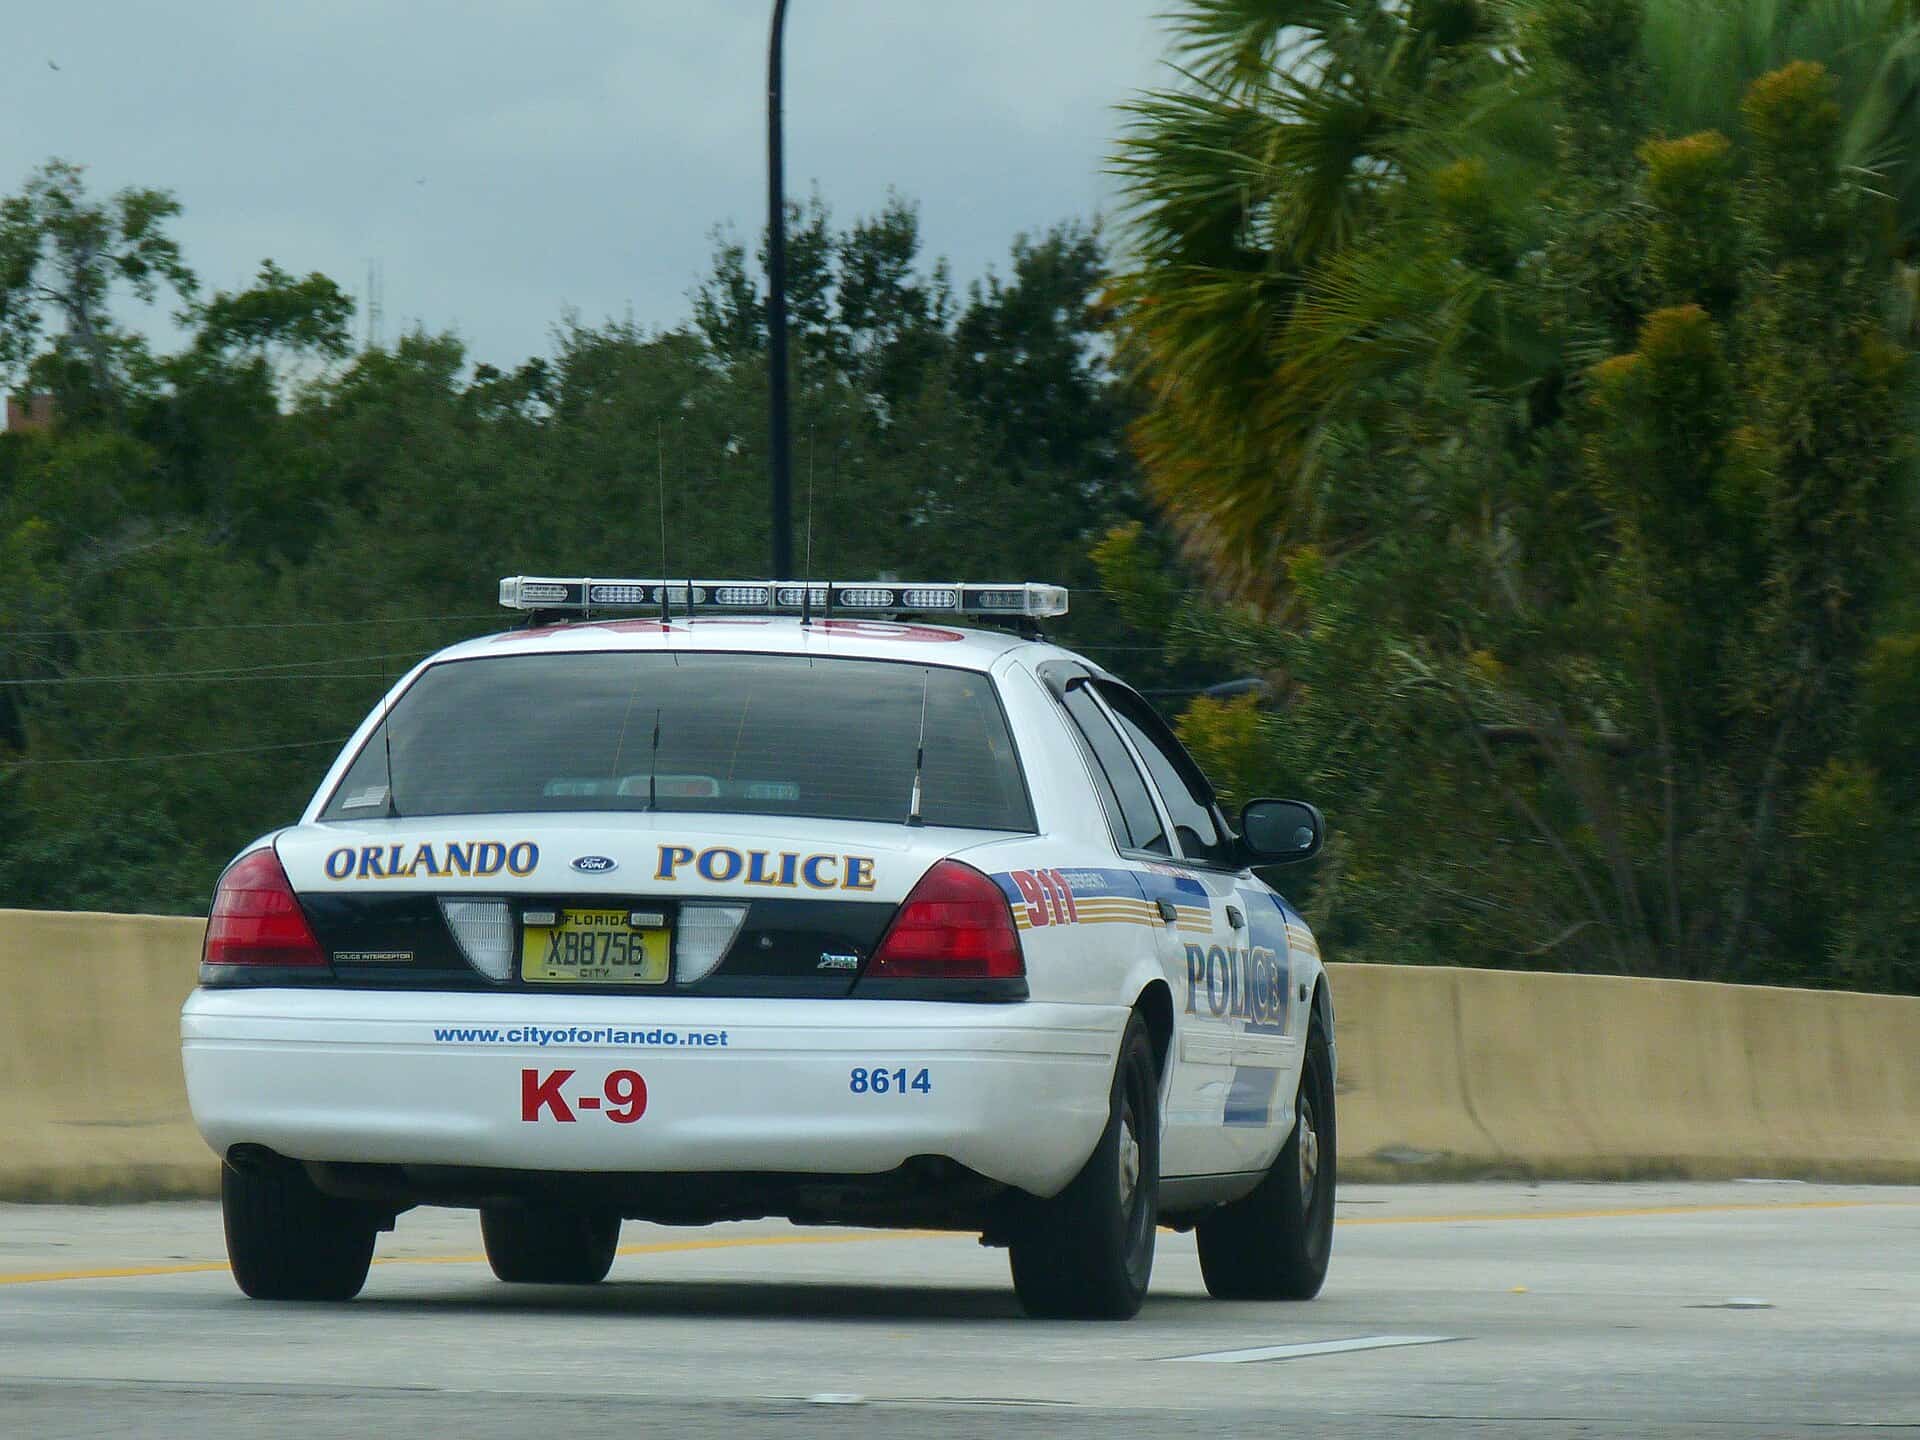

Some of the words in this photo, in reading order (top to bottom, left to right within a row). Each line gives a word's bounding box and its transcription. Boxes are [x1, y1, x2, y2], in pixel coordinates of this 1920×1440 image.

[324, 841, 540, 880] ORLANDO
[654, 844, 876, 891] POLICE
[1009, 868, 1078, 927] 911
[579, 968, 610, 978] CITY
[1184, 943, 1281, 1026] POLICE
[434, 1026, 728, 1046] www.cityoforlando.net
[521, 1069, 648, 1124] K-9
[849, 1067, 931, 1094] 8614
